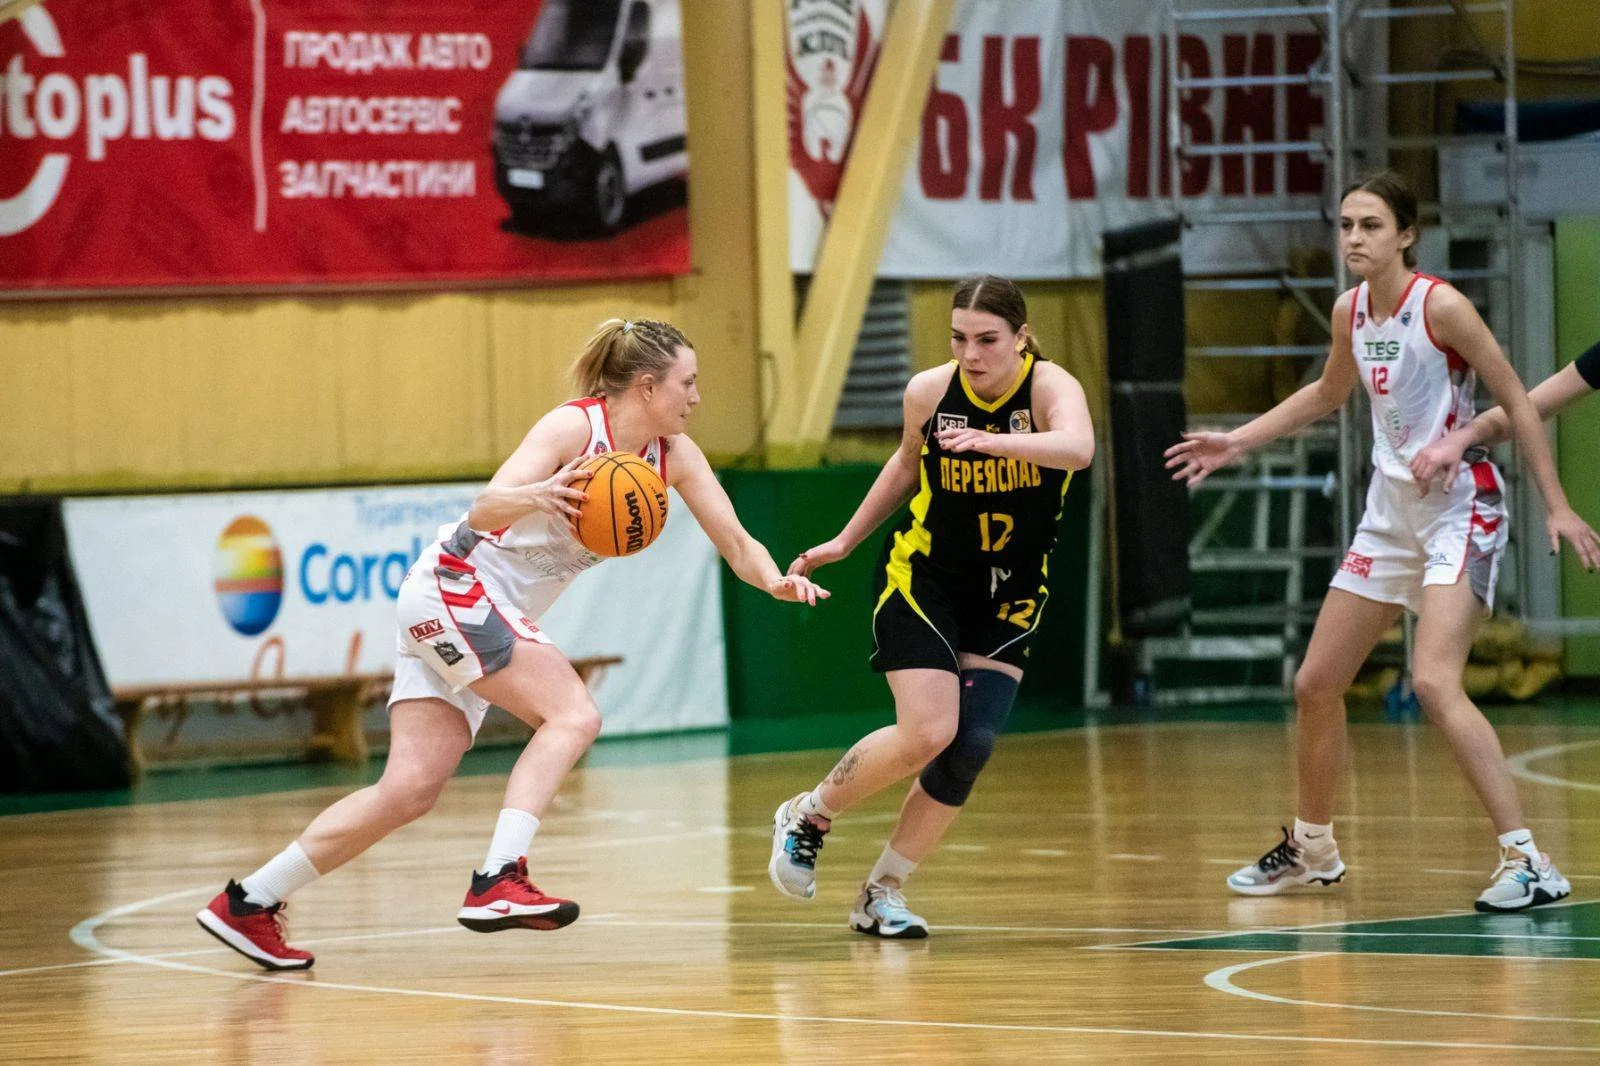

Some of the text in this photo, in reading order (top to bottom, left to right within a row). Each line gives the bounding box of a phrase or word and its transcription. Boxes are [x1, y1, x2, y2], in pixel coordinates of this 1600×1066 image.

[283, 31, 493, 75] ПРОДАЖ АВТО
[0, 51, 237, 162] toplus
[280, 96, 463, 135] АВТОСЕРВІС
[919, 33, 1325, 203] БК РІВНЕ
[279, 160, 478, 198] ЗАПЧАСТИНИ
[1364, 340, 1400, 356] TEG
[1372, 366, 1389, 395] 12
[941, 418, 964, 429] KRP
[940, 456, 1042, 494] ПЕРЕЯСЛАВ
[624, 489, 644, 554] Wilson
[978, 512, 1014, 552] 12
[996, 599, 1036, 630] 12
